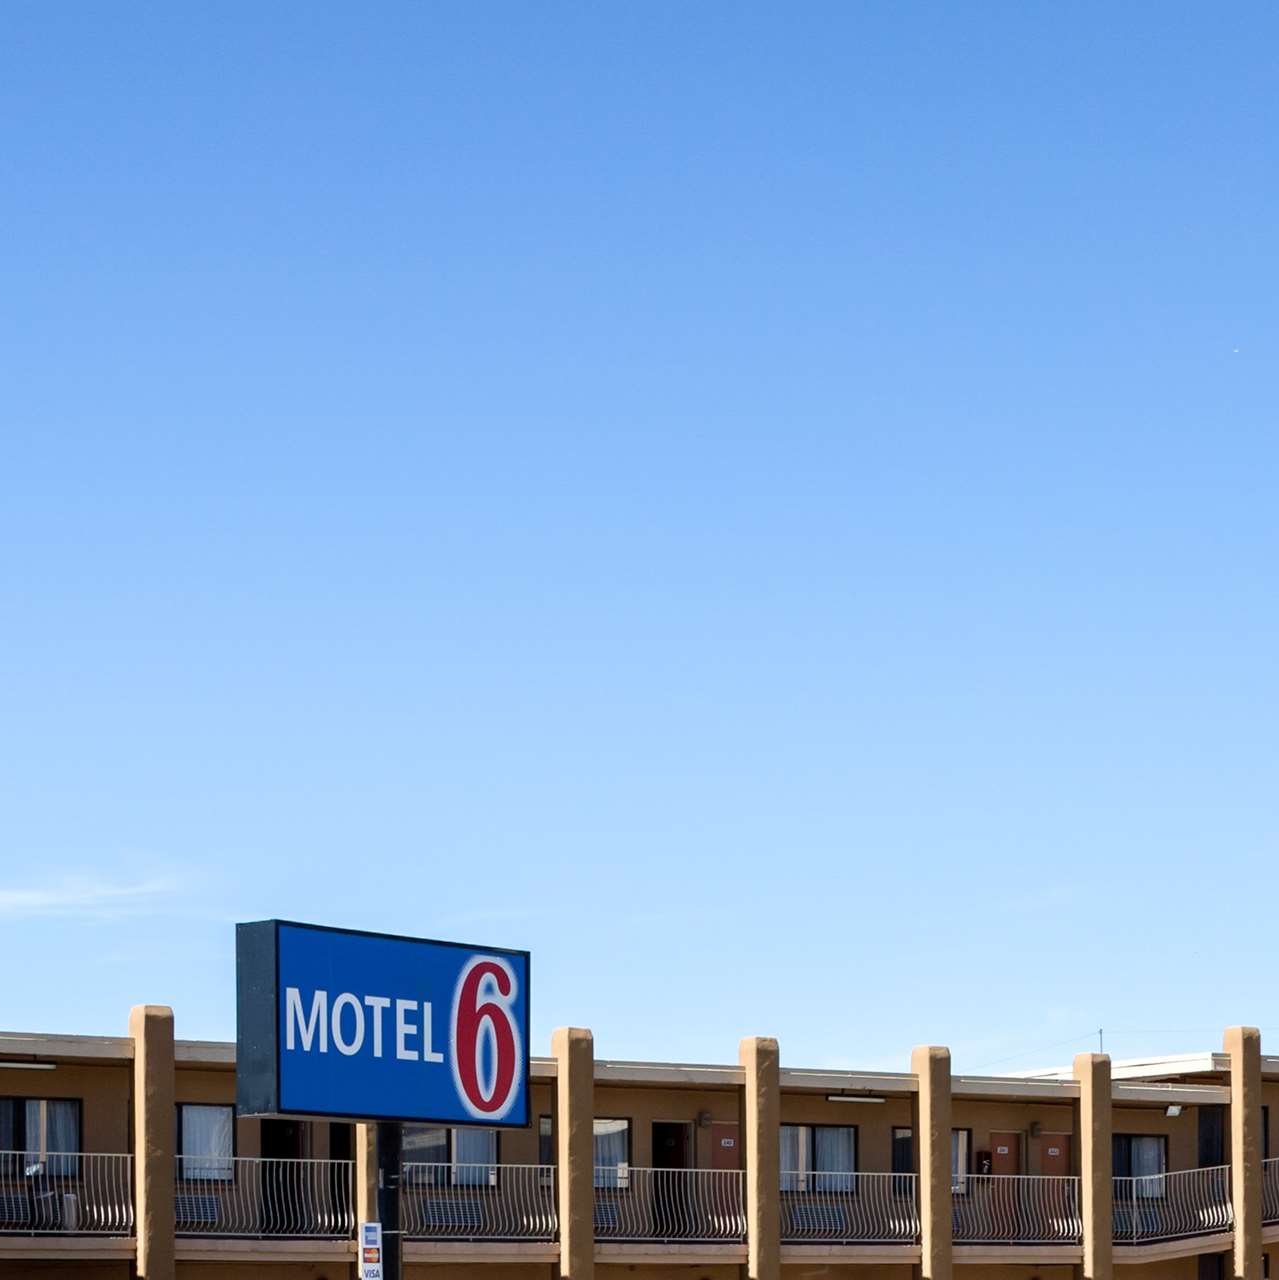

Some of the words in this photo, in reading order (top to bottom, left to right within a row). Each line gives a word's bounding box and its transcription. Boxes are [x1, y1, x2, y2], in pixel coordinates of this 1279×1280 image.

[285, 986, 444, 1063] MOTEL
[454, 959, 517, 1114] 6
[364, 1269, 380, 1278] VISA
